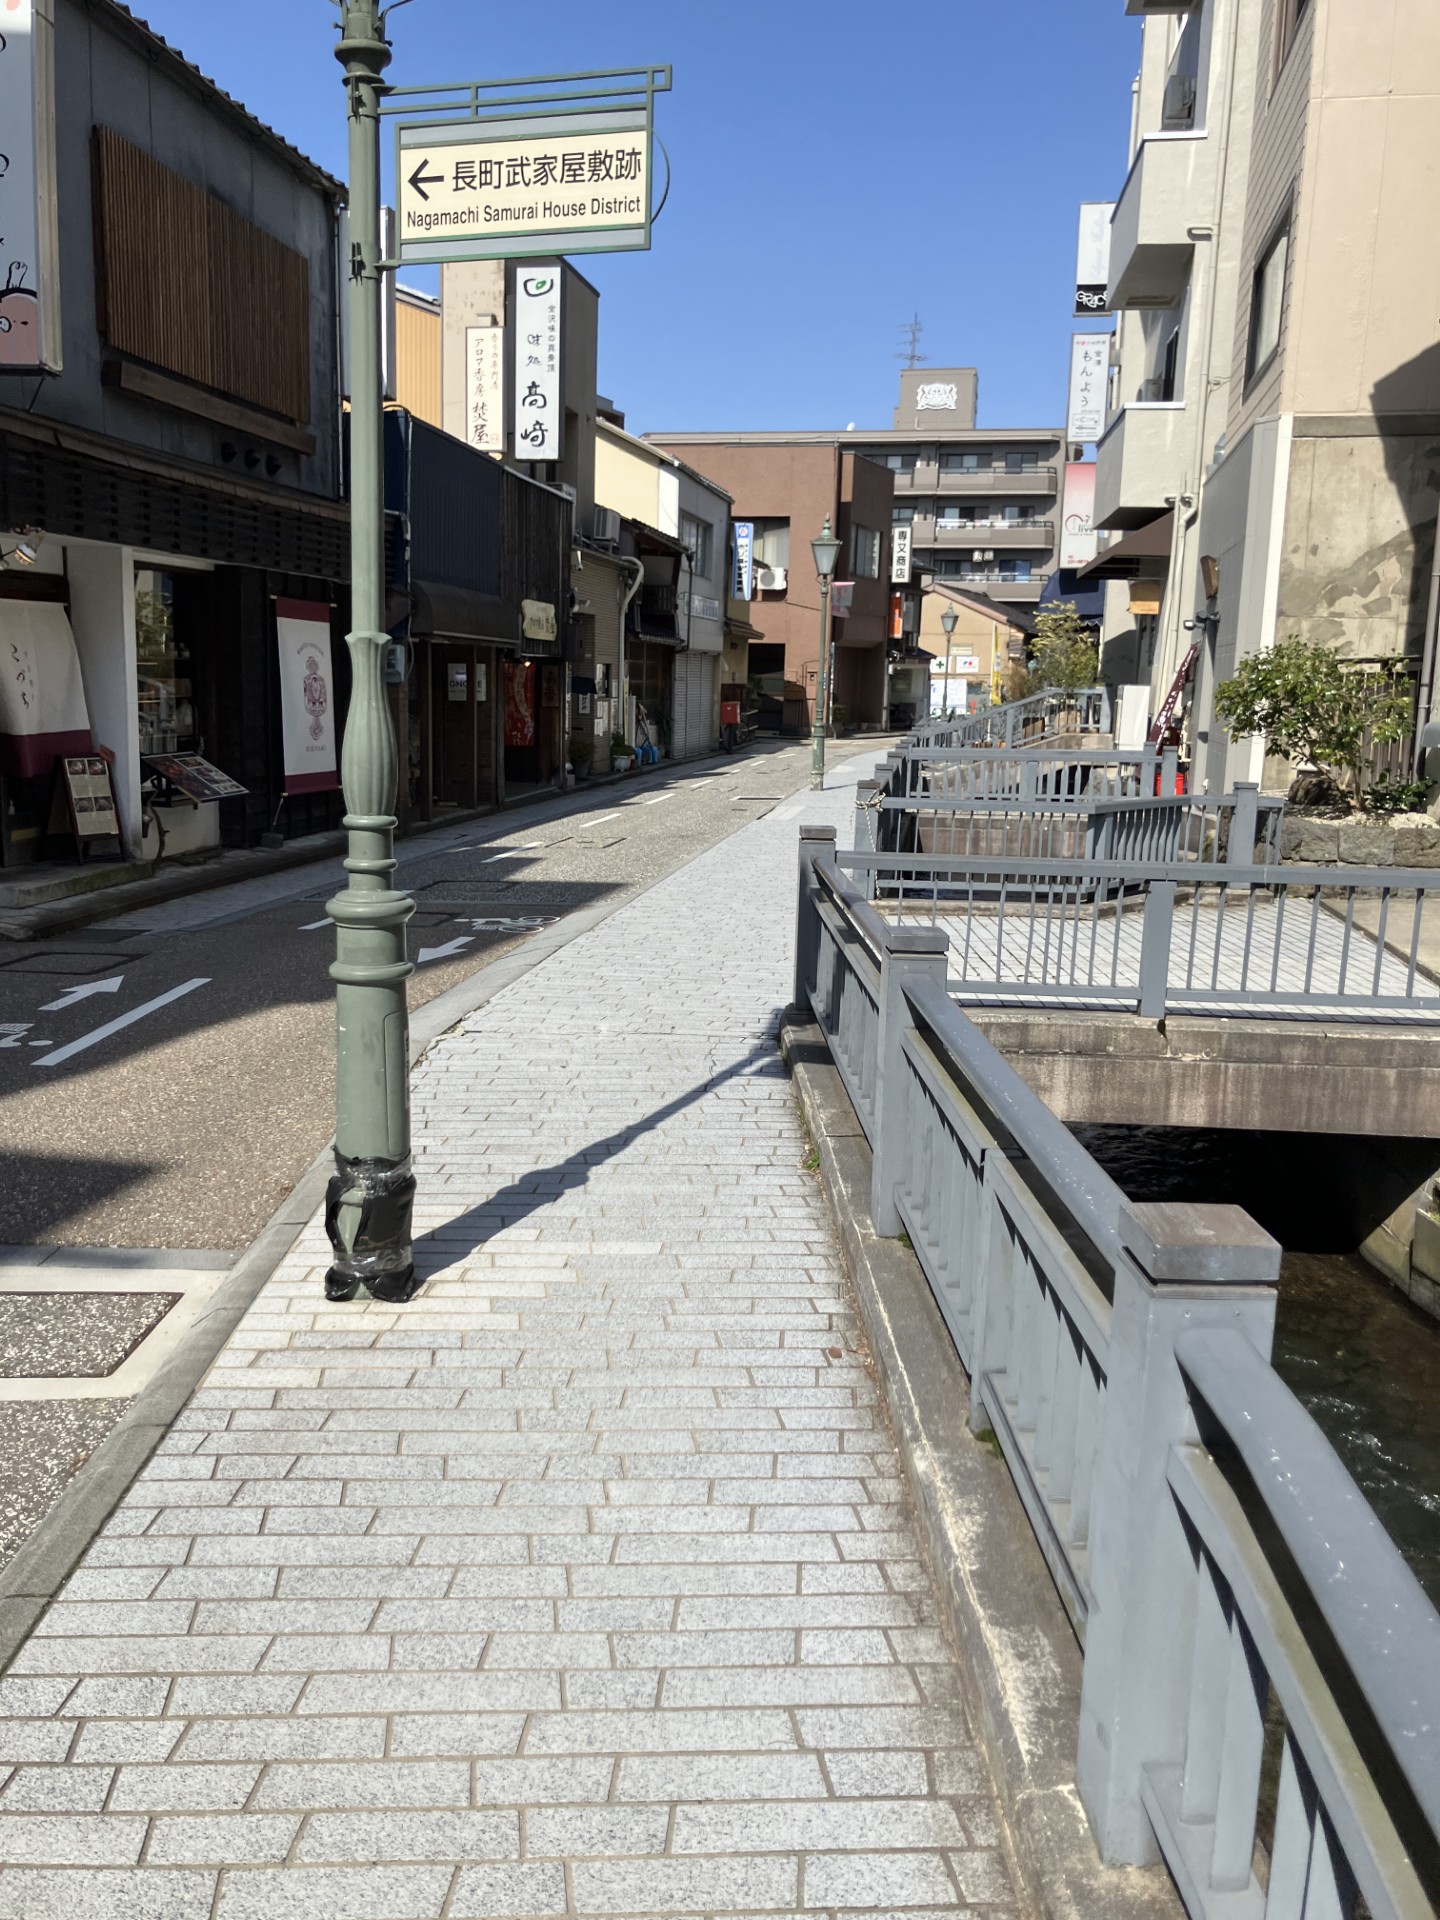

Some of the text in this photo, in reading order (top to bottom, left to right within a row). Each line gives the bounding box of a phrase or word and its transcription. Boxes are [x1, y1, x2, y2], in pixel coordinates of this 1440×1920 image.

[452, 147, 642, 192] 長町武家屋敷跡
[407, 196, 641, 231] Nagamachi Samurai House District
[1080, 350, 1092, 407] もんよう
